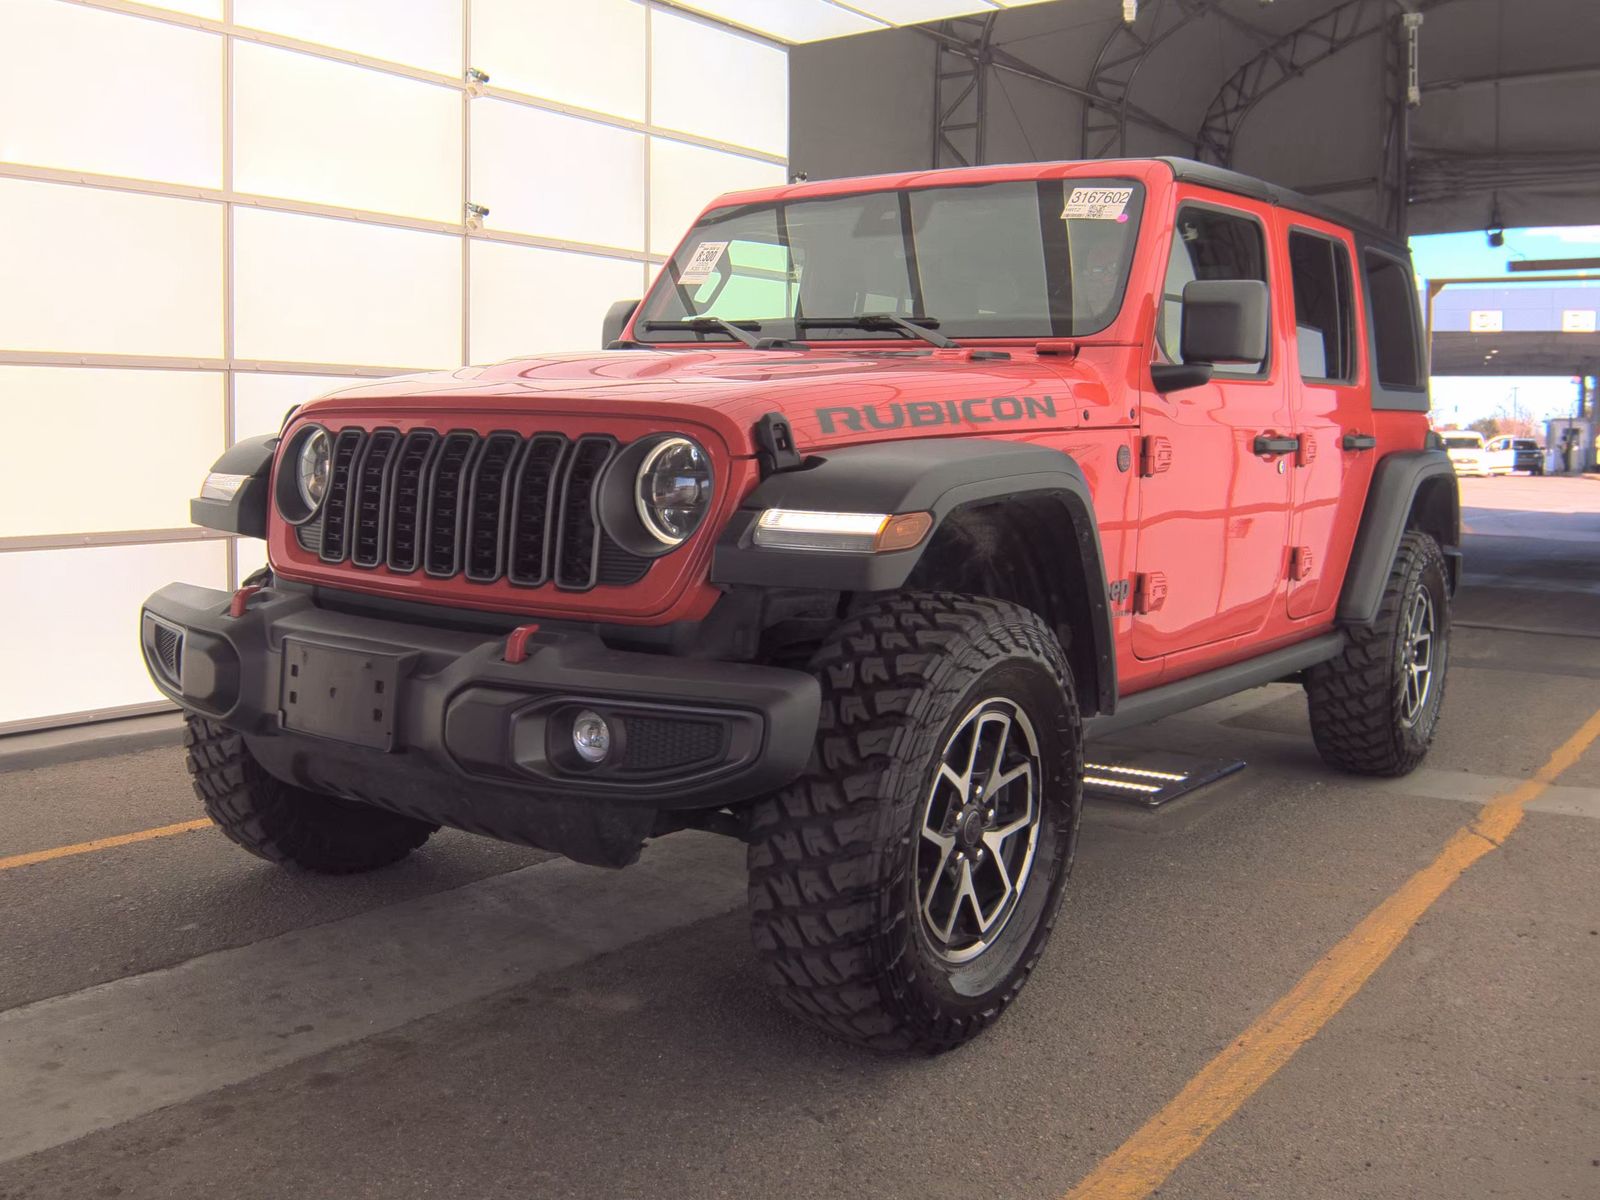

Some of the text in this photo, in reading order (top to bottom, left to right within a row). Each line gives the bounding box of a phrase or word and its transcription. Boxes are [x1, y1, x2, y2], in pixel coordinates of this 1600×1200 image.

[1071, 191, 1131, 204] 3167602
[815, 395, 1057, 434] RUBICON
[1109, 579, 1130, 605] ep
